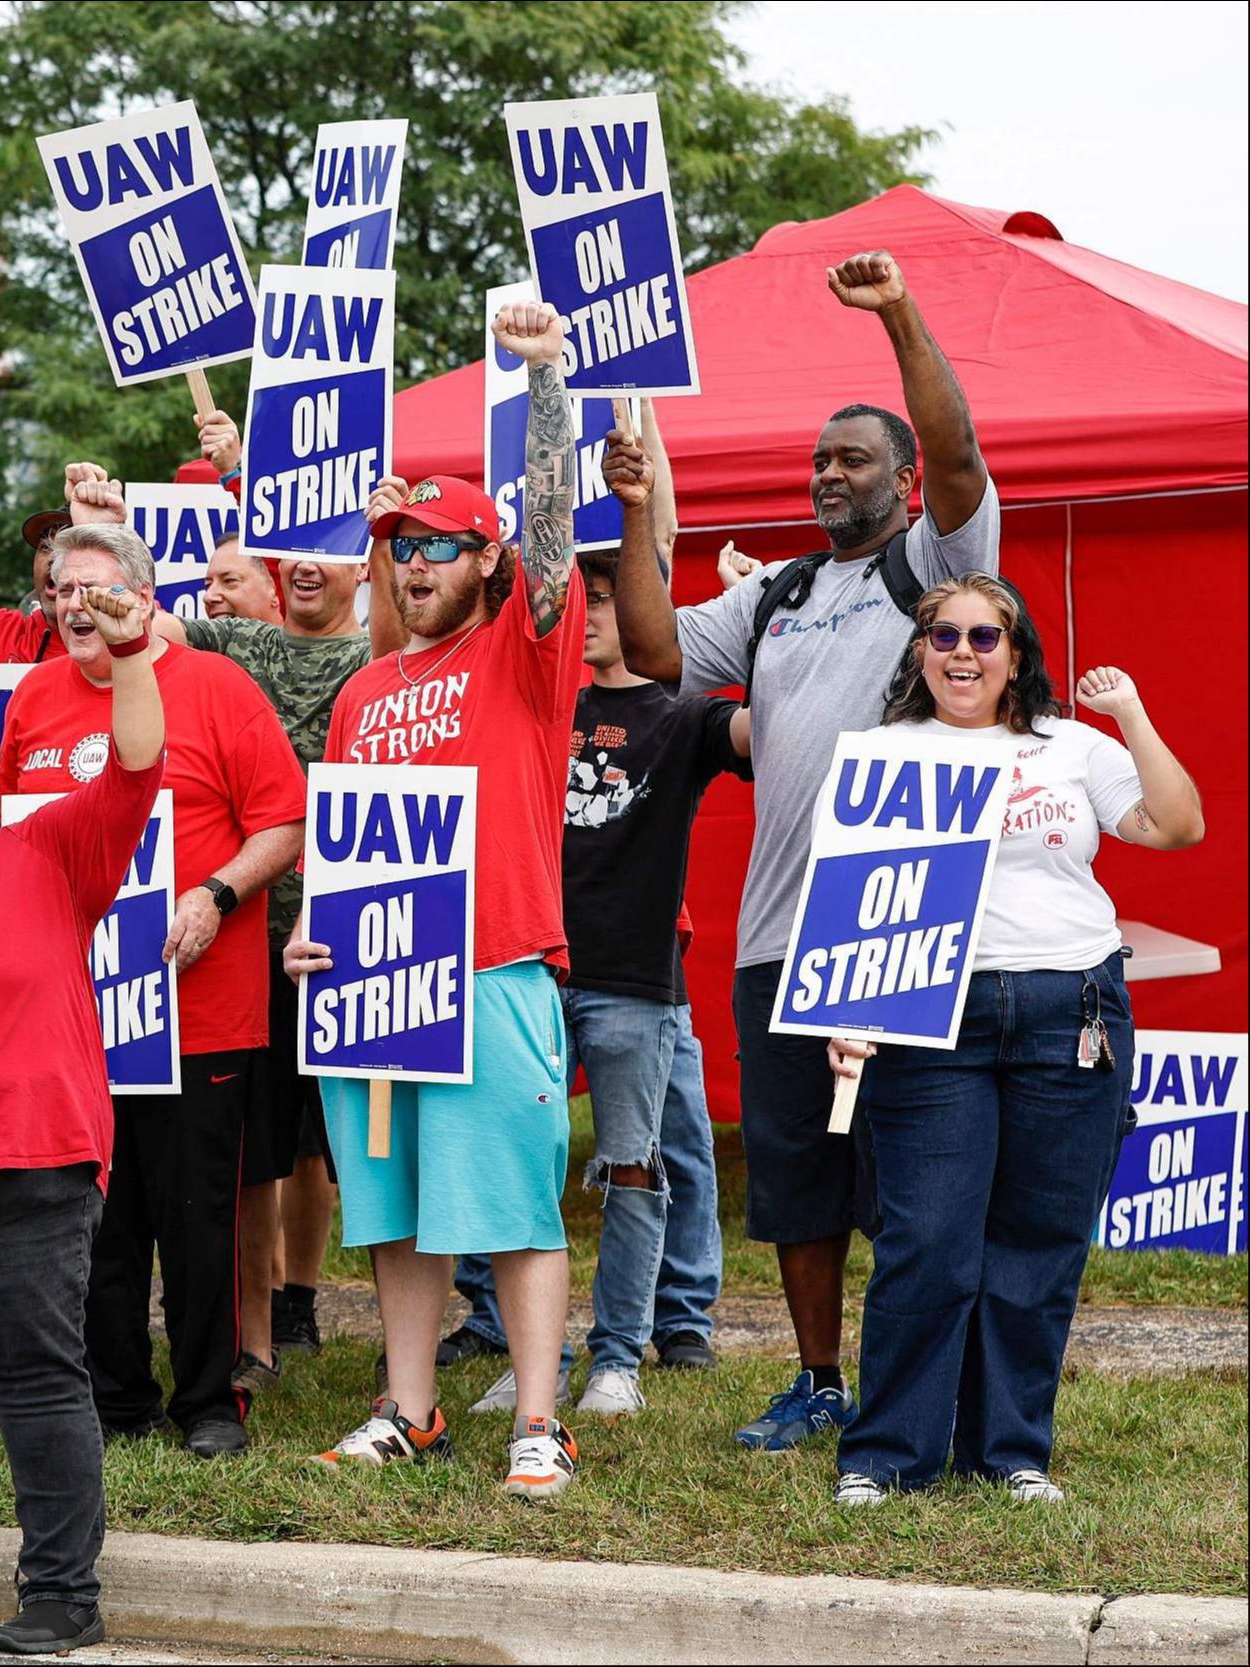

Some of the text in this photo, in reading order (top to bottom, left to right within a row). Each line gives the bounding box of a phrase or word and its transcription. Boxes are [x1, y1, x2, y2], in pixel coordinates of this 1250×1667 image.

[54, 125, 193, 211] UAW
[315, 145, 396, 208] UAW
[517, 120, 648, 196] UAW
[129, 214, 186, 287] ON
[574, 223, 626, 294] ON
[111, 253, 243, 365] STRIKE
[261, 292, 385, 363] UAW
[562, 273, 677, 377] STRIKE
[291, 388, 340, 458] ON
[252, 447, 376, 535] STRIKE
[769, 598, 884, 637] Chmpon
[350, 710, 461, 765] STRONG
[358, 672, 470, 736] UNION
[22, 748, 105, 771] LOCAL UAW
[833, 758, 1001, 835] UAW
[316, 791, 464, 866] UAW
[358, 892, 413, 969] ON
[859, 859, 929, 931] ON
[90, 913, 120, 982] N
[792, 921, 964, 1013] STRIKE
[96, 969, 164, 1051] IKE
[313, 954, 457, 1055] STRIKE
[1149, 1126, 1195, 1184] ON
[1110, 1171, 1227, 1248] STRIKE
